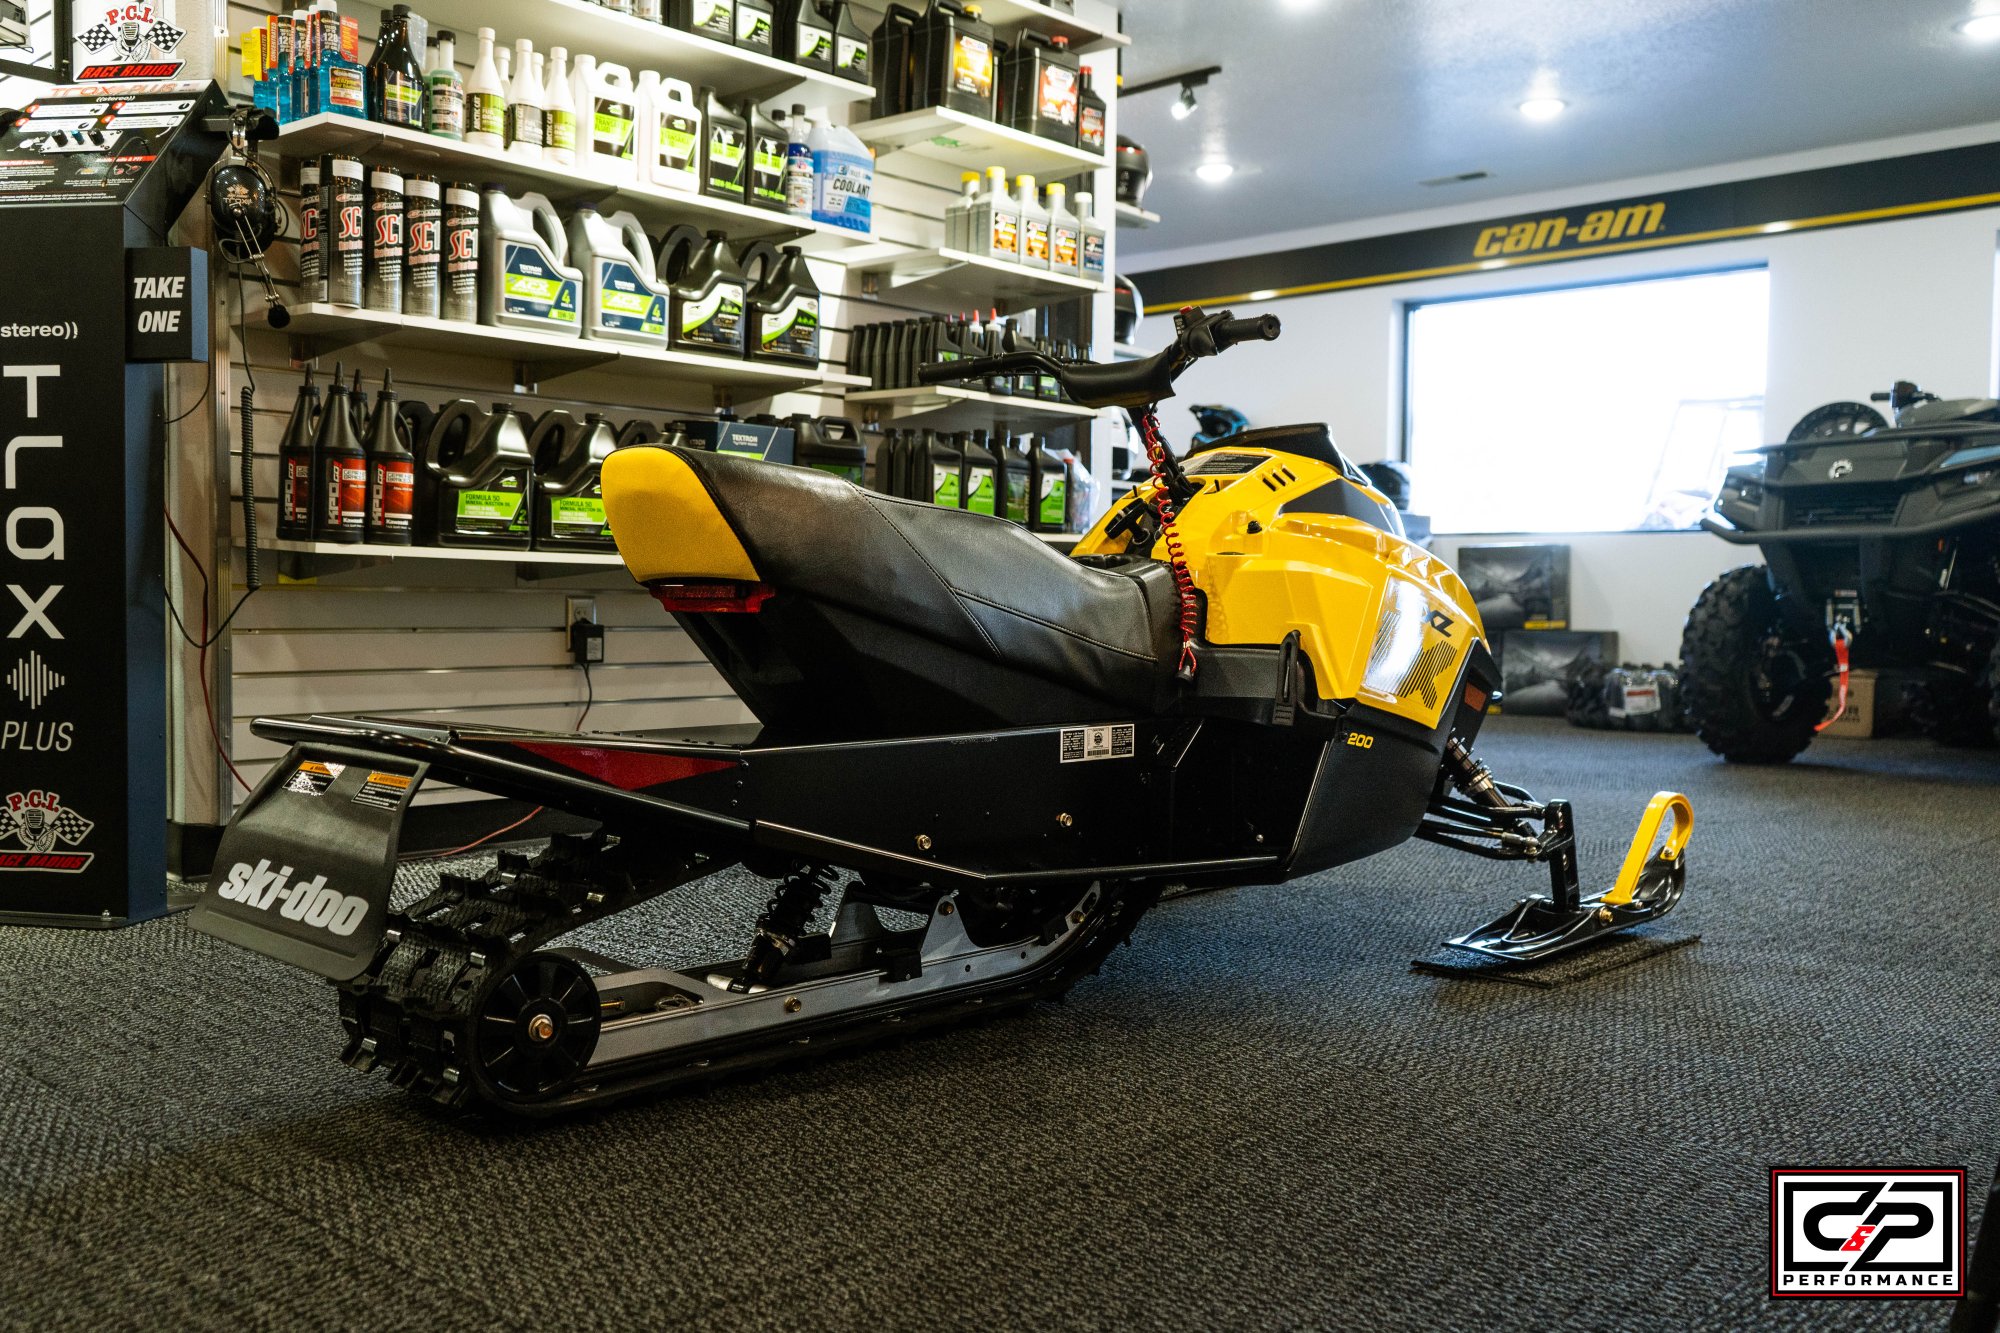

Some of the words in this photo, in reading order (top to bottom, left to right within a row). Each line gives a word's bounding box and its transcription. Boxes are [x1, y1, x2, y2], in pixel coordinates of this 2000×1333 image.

[106, 5, 154, 25] P.C.I.
[80, 67, 119, 79] RACE
[120, 64, 177, 78] RADIOS
[833, 178, 871, 198] COOLANT
[375, 214, 404, 246] SC1
[409, 220, 440, 254] SC1
[1473, 202, 1666, 257] can-am
[449, 228, 479, 261] SC1
[134, 276, 185, 299] TAKE
[137, 310, 181, 333] ONE
[519, 509, 527, 521] 2
[1, 721, 74, 751] PLUS
[1347, 732, 1374, 749] 200
[8, 791, 60, 812] P.C.I.
[0, 854, 25, 867] ACE
[25, 855, 86, 868] RADIOS
[217, 858, 370, 937] ski-doo
